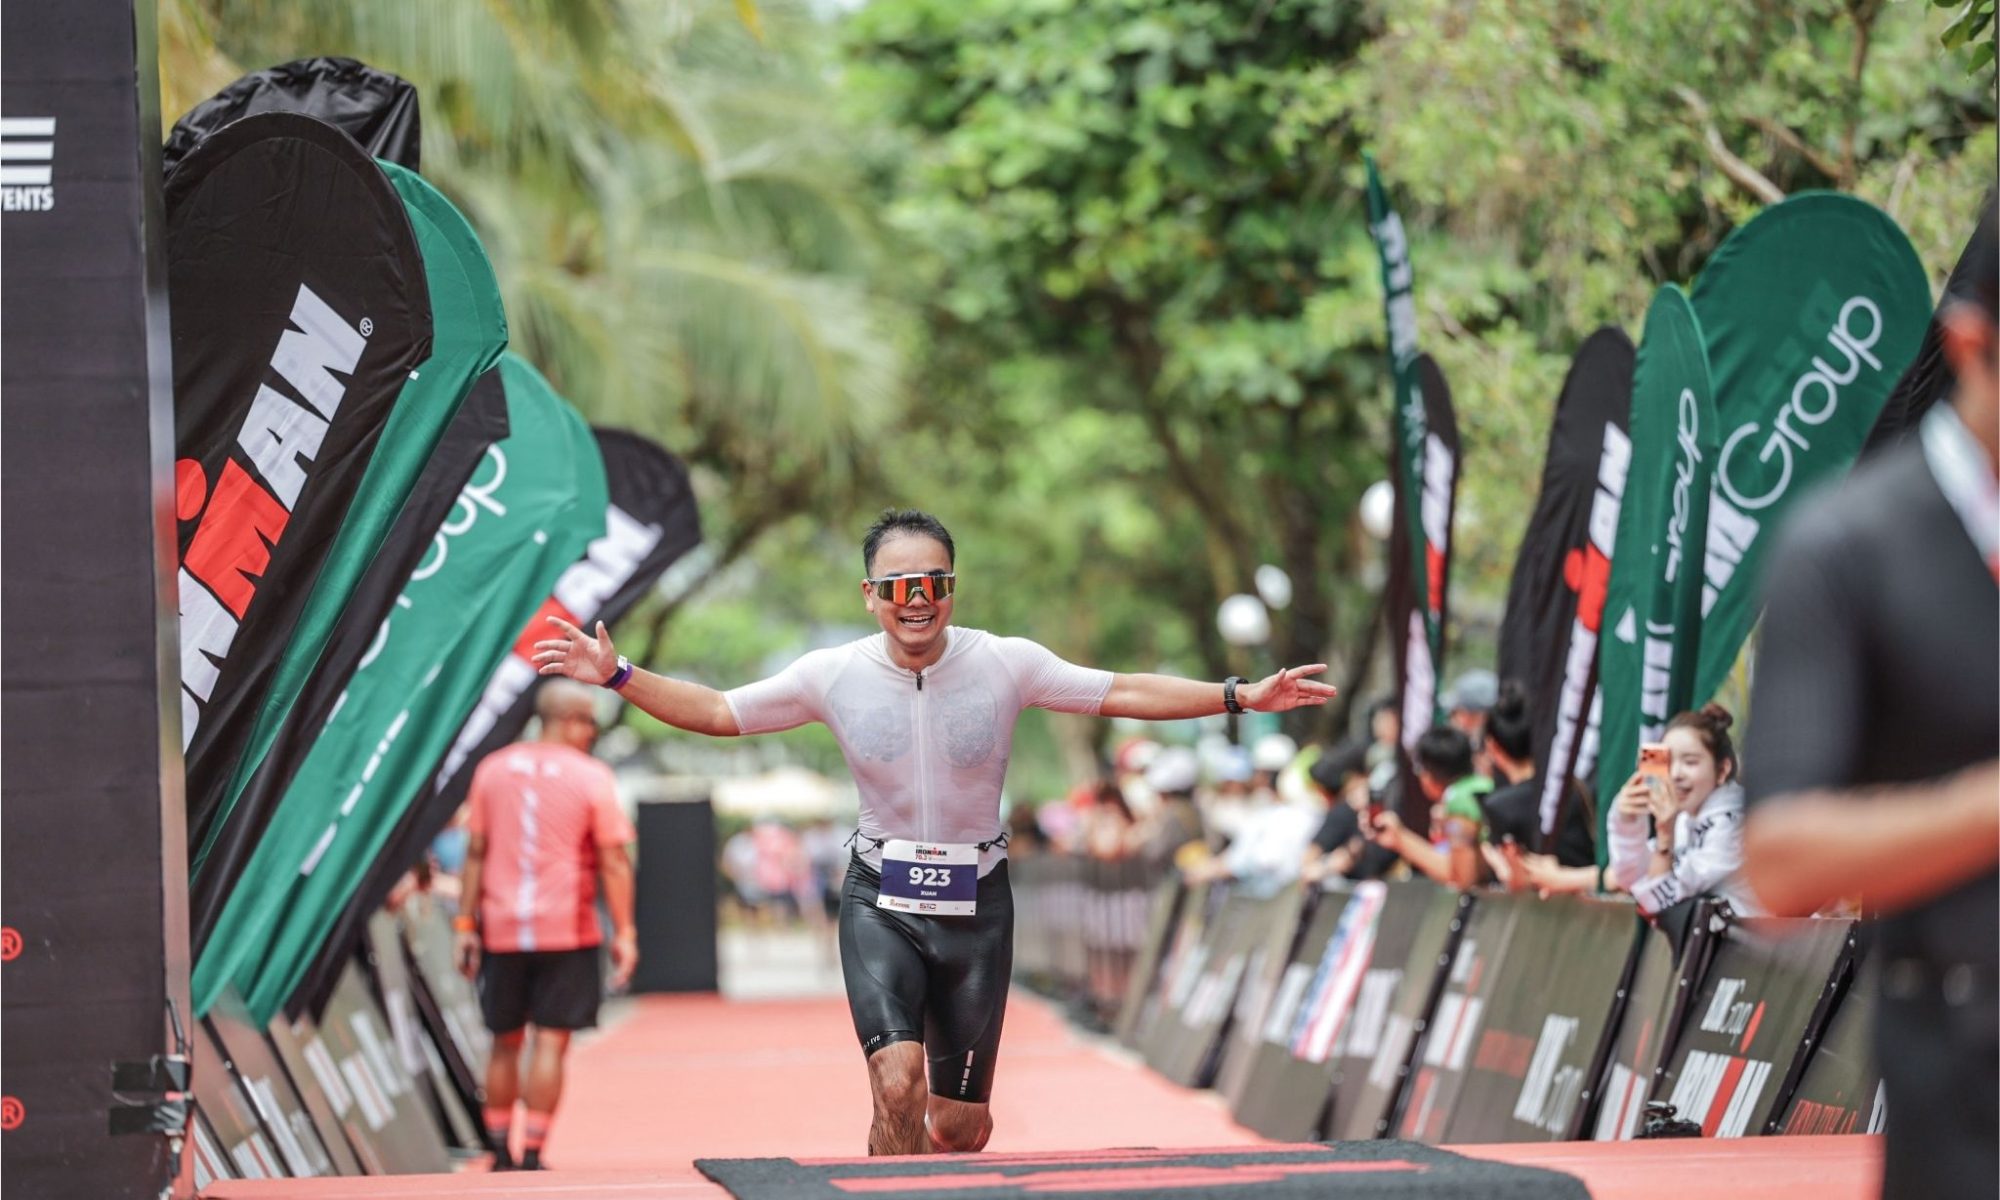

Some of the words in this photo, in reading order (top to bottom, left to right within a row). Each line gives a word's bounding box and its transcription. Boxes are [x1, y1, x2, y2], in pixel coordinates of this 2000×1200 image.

[0, 187, 54, 211] ENTS
[1717, 295, 1883, 510] Group
[915, 847, 947, 856] IRONMAN
[908, 866, 951, 887] 923
